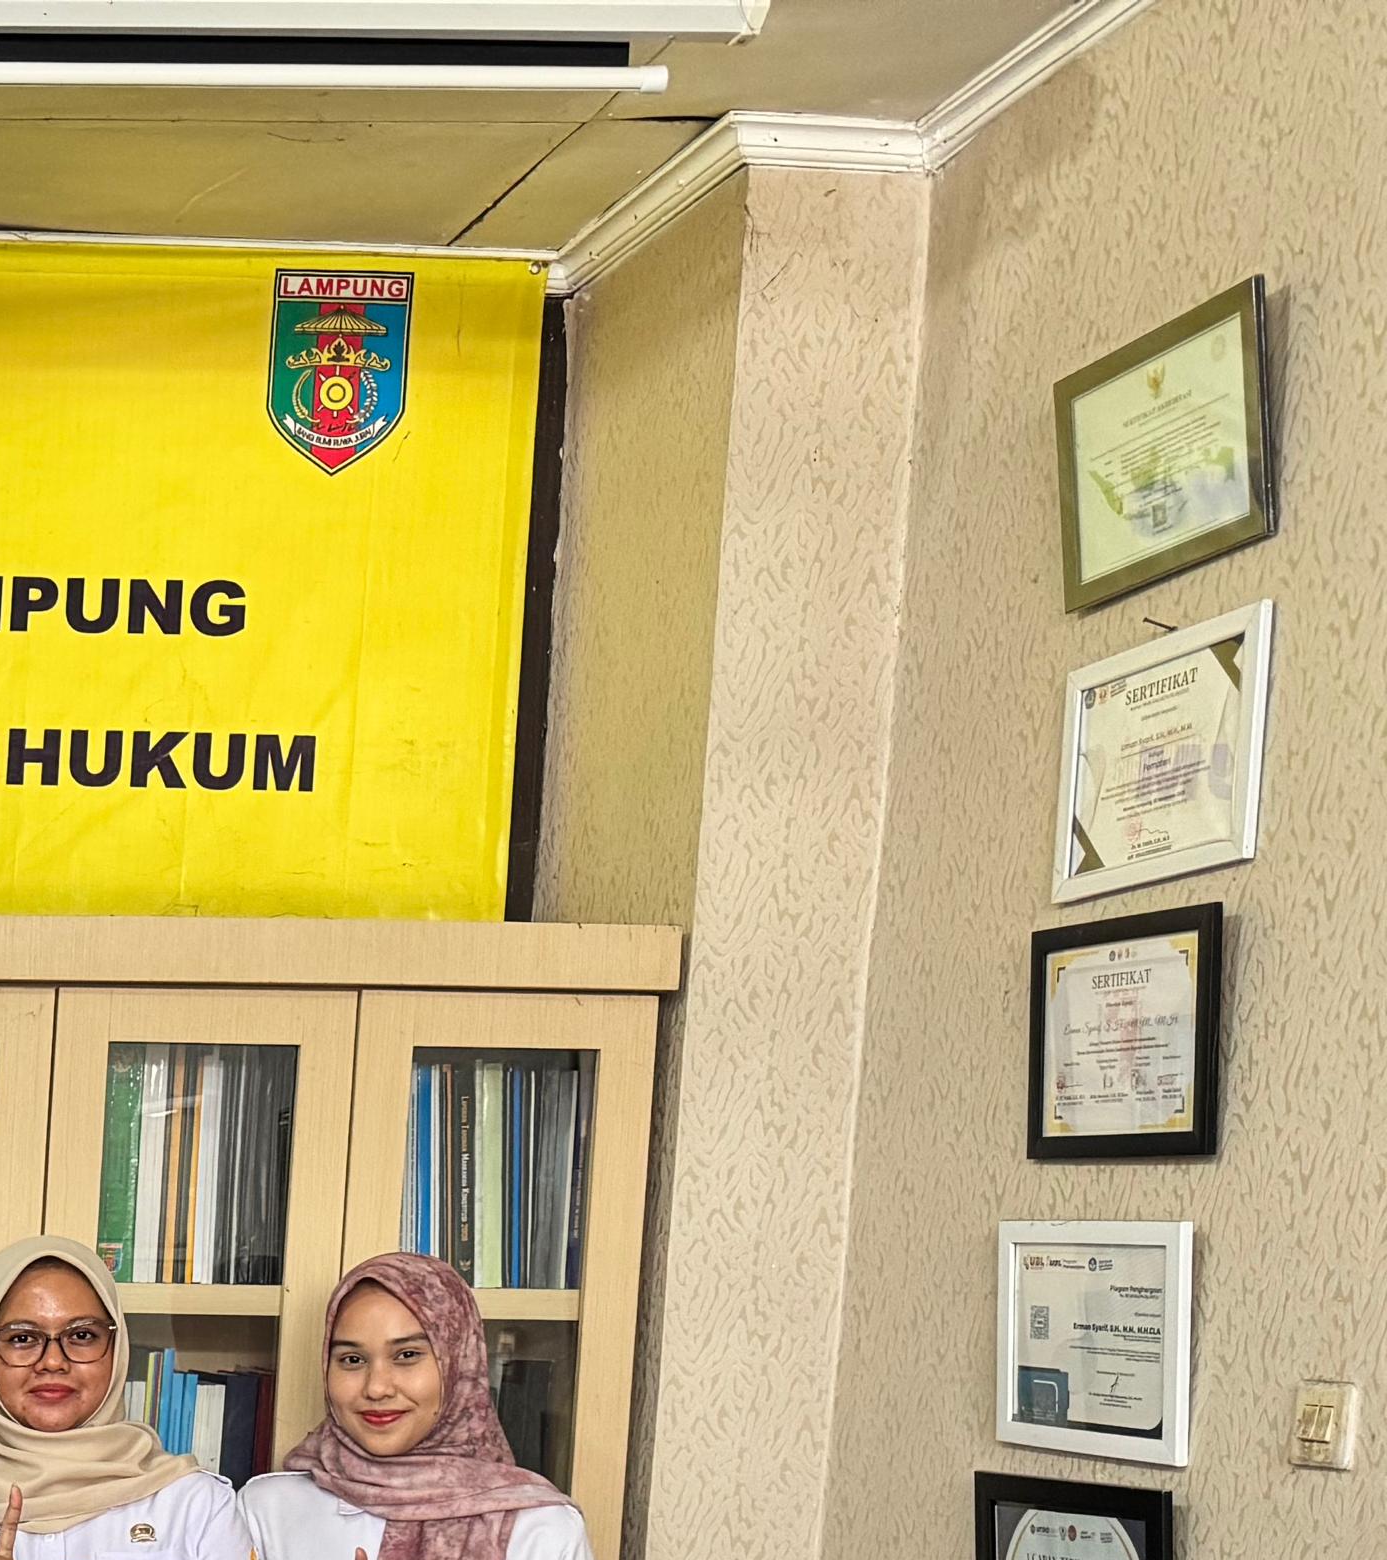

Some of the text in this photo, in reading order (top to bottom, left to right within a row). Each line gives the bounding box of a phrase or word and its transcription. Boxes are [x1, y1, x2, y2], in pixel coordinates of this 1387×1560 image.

[283, 278, 404, 297] LAMPUNG
[1125, 667, 1198, 706] SERTIFIKAT
[6, 727, 318, 794] HUKUM
[1092, 968, 1151, 990] SERTIFIKAT
